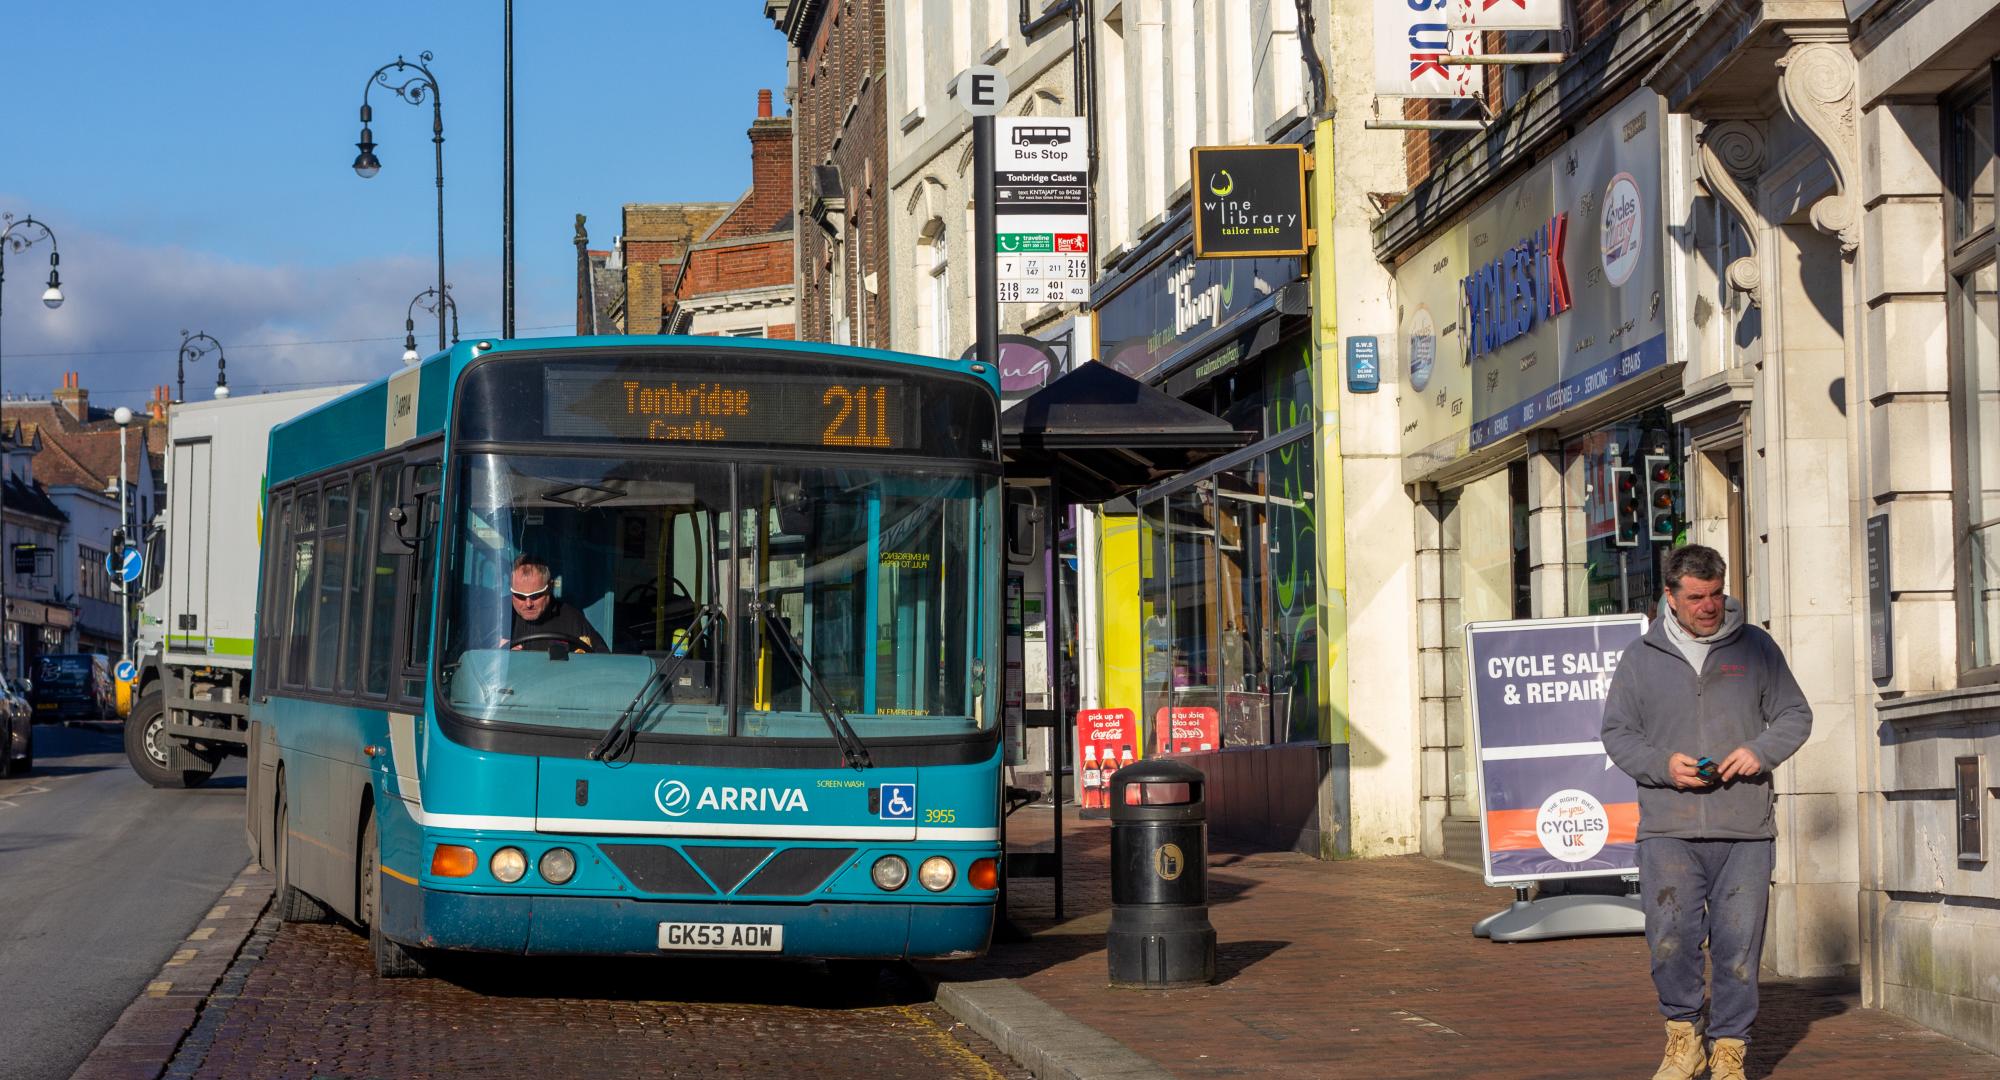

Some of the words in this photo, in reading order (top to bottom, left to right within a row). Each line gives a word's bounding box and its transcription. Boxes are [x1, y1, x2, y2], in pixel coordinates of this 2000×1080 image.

[972, 75, 994, 105] E
[1015, 149, 1038, 159] Bus
[1041, 149, 1068, 161] Stop
[1007, 174, 1049, 183] Tonbridge
[1051, 174, 1077, 182] Castle
[1204, 198, 1251, 211] wine
[1221, 205, 1296, 227] library
[1222, 227, 1250, 235] tailor
[1253, 226, 1280, 234] made
[1006, 264, 1012, 272] 7
[1068, 260, 1086, 268] 216
[1068, 269, 1086, 278] 217
[1000, 283, 1019, 291] 218
[1048, 281, 1063, 289] 401
[1000, 292, 1019, 300] 219
[1047, 292, 1064, 300] 402
[1584, 368, 1608, 394] SERVICING
[1621, 351, 1641, 377] REPAIRS
[624, 380, 750, 417] Tonbridge
[822, 386, 892, 447] 211
[648, 420, 727, 441] Castle
[1488, 655, 1556, 679] CYCLE
[1503, 684, 1521, 706] &
[1088, 713, 1103, 722] pick
[816, 779, 842, 788] SCREEN
[844, 780, 865, 788] WASH
[696, 786, 809, 812] ARRIVA
[1581, 799, 1595, 811] BIKE
[925, 809, 956, 823] 3955
[1541, 817, 1604, 834] CYCLES
[1562, 834, 1585, 847] UK
[667, 924, 724, 946] GK53
[731, 926, 773, 947] AOW
